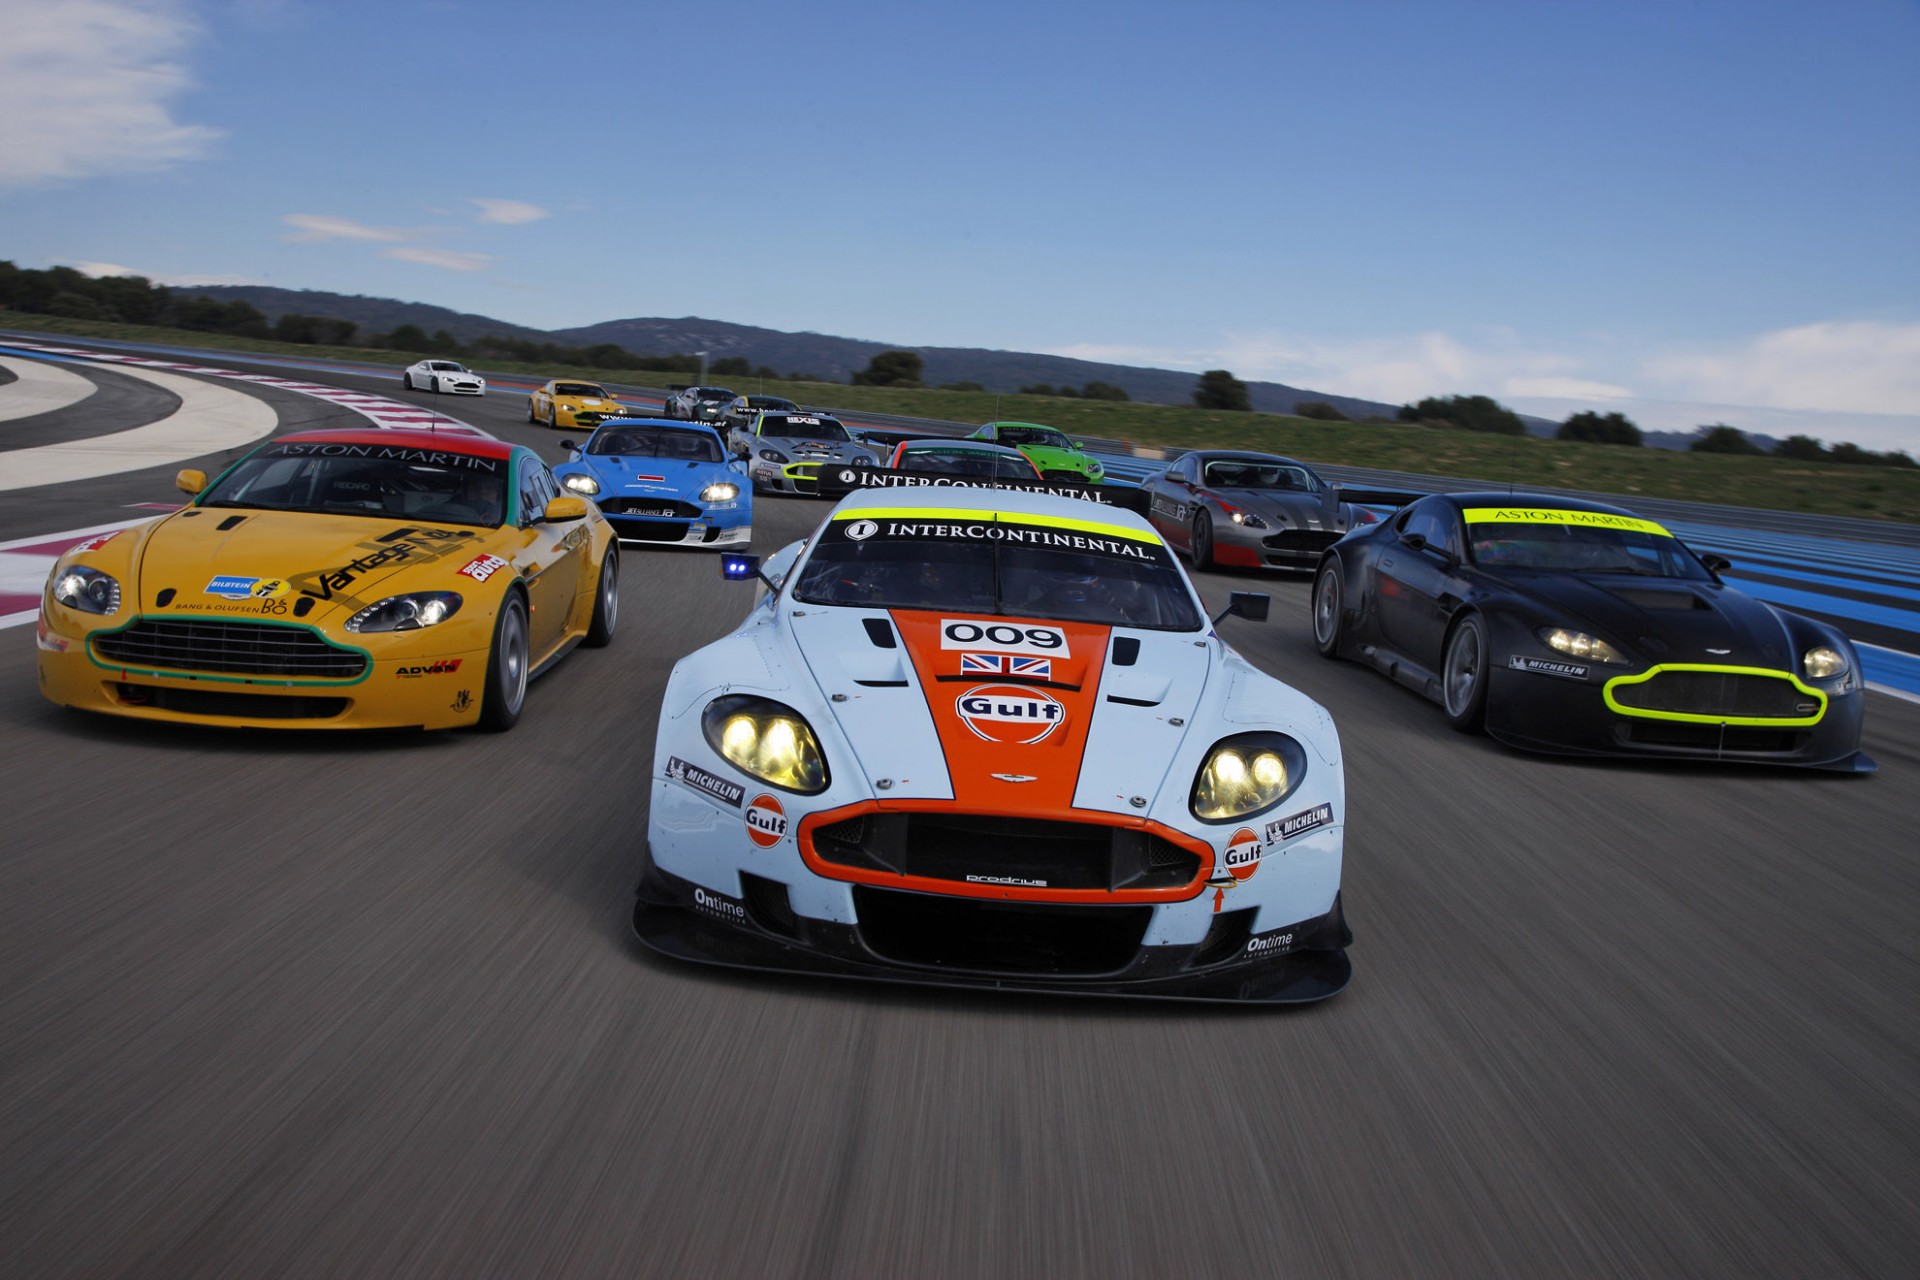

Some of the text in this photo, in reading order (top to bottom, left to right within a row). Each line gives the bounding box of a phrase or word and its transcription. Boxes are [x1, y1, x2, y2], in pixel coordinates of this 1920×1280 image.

[269, 444, 496, 471] ASTON MARTIN
[1495, 511, 1644, 529] ASTON MARTIN
[214, 605, 260, 613] OLUFSEN
[945, 623, 1063, 649] 009
[396, 664, 456, 674] ADVAN
[1528, 660, 1586, 675] MICHELIN
[961, 697, 1059, 720] Gulf
[686, 768, 741, 800] MICHELIN
[746, 808, 787, 834] Gulf
[1284, 807, 1328, 834] MICHELIN
[1225, 844, 1262, 866] Gulf
[966, 874, 1047, 887] prodrive
[695, 888, 744, 917] Ontime
[1247, 933, 1292, 952] Ontime
